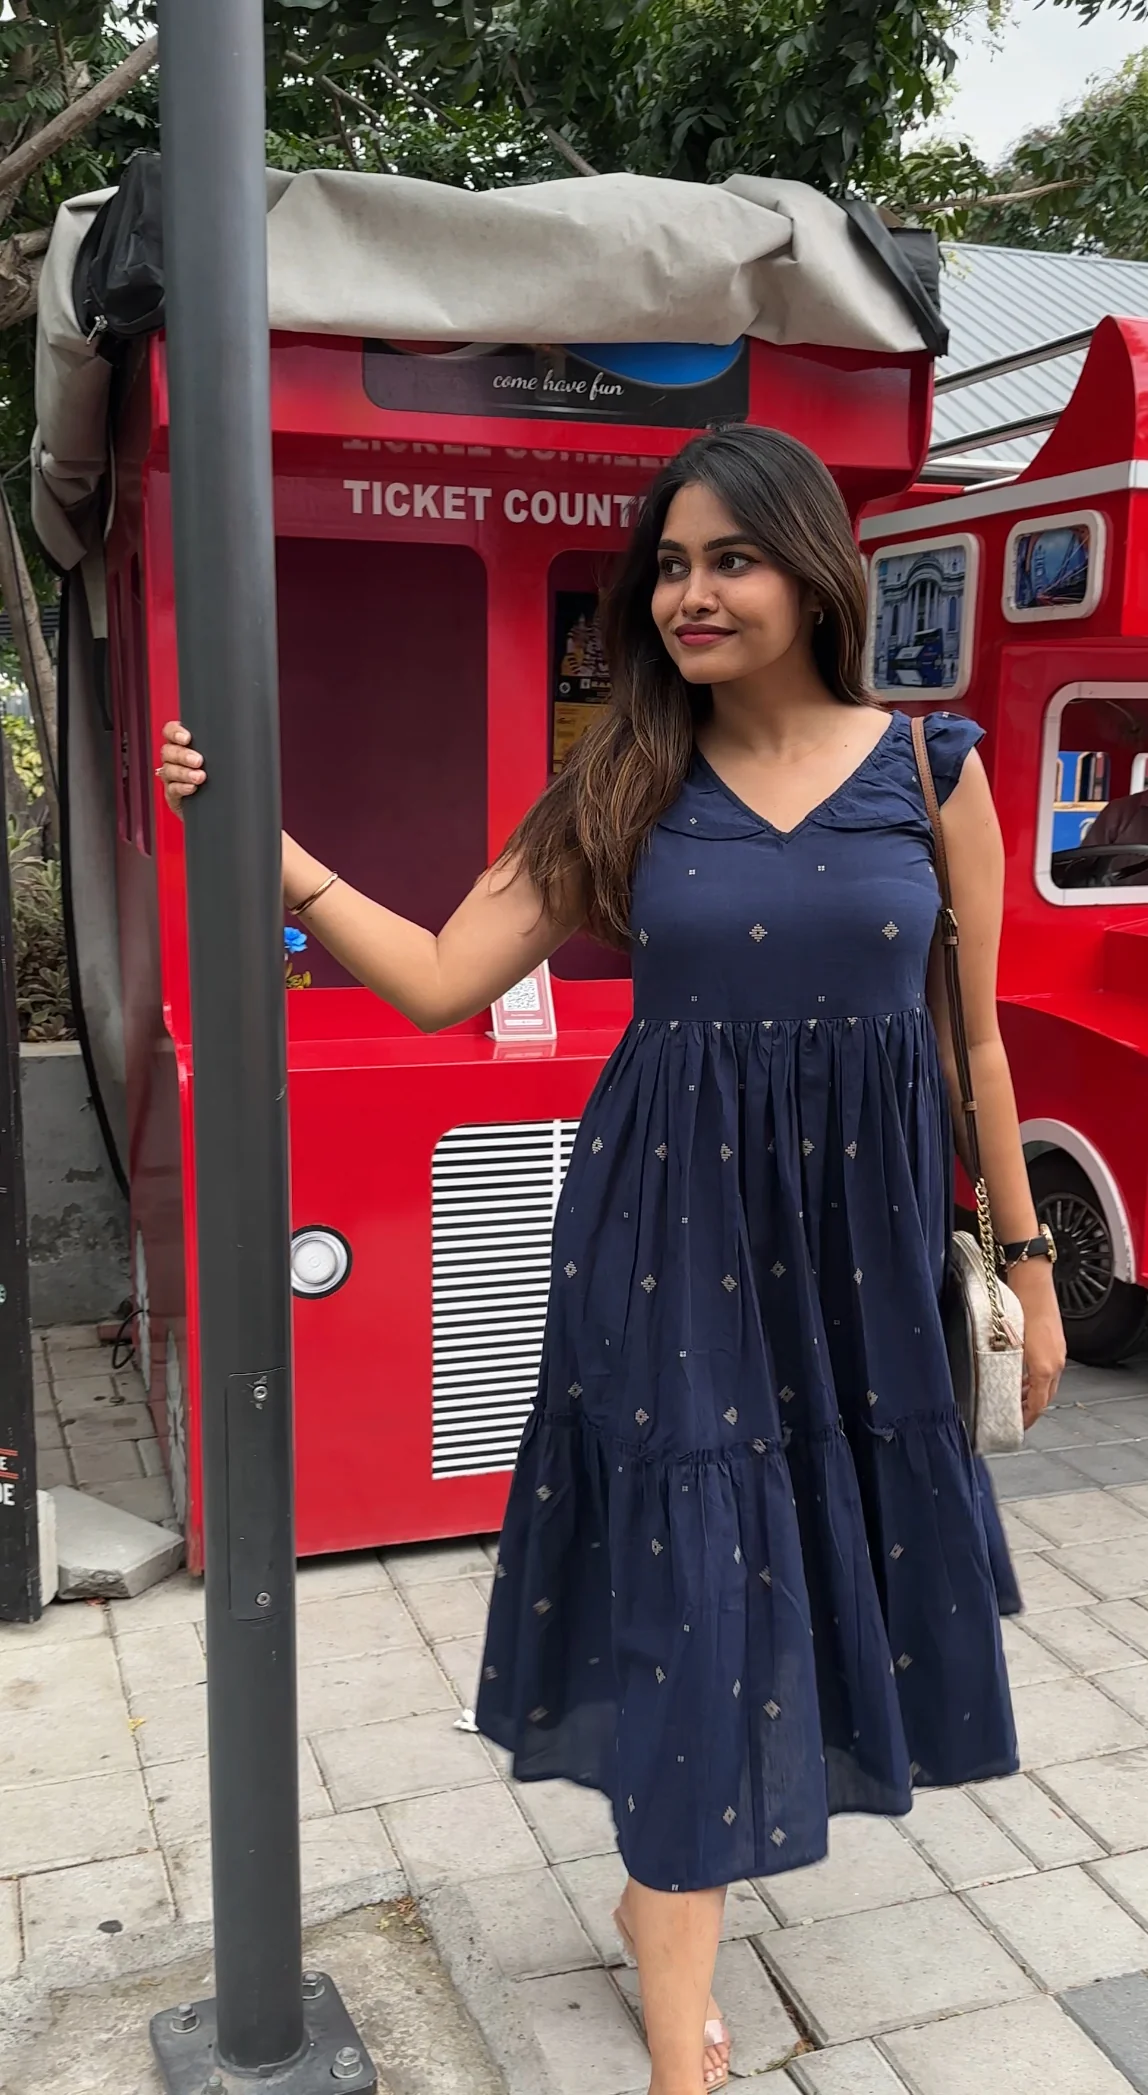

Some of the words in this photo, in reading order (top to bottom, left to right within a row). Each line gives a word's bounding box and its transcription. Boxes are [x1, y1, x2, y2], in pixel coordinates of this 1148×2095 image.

[493, 375, 538, 390] come
[543, 369, 587, 394] have
[589, 371, 625, 401] fun
[343, 479, 492, 521] TICKET
[503, 488, 647, 528] COUNT
